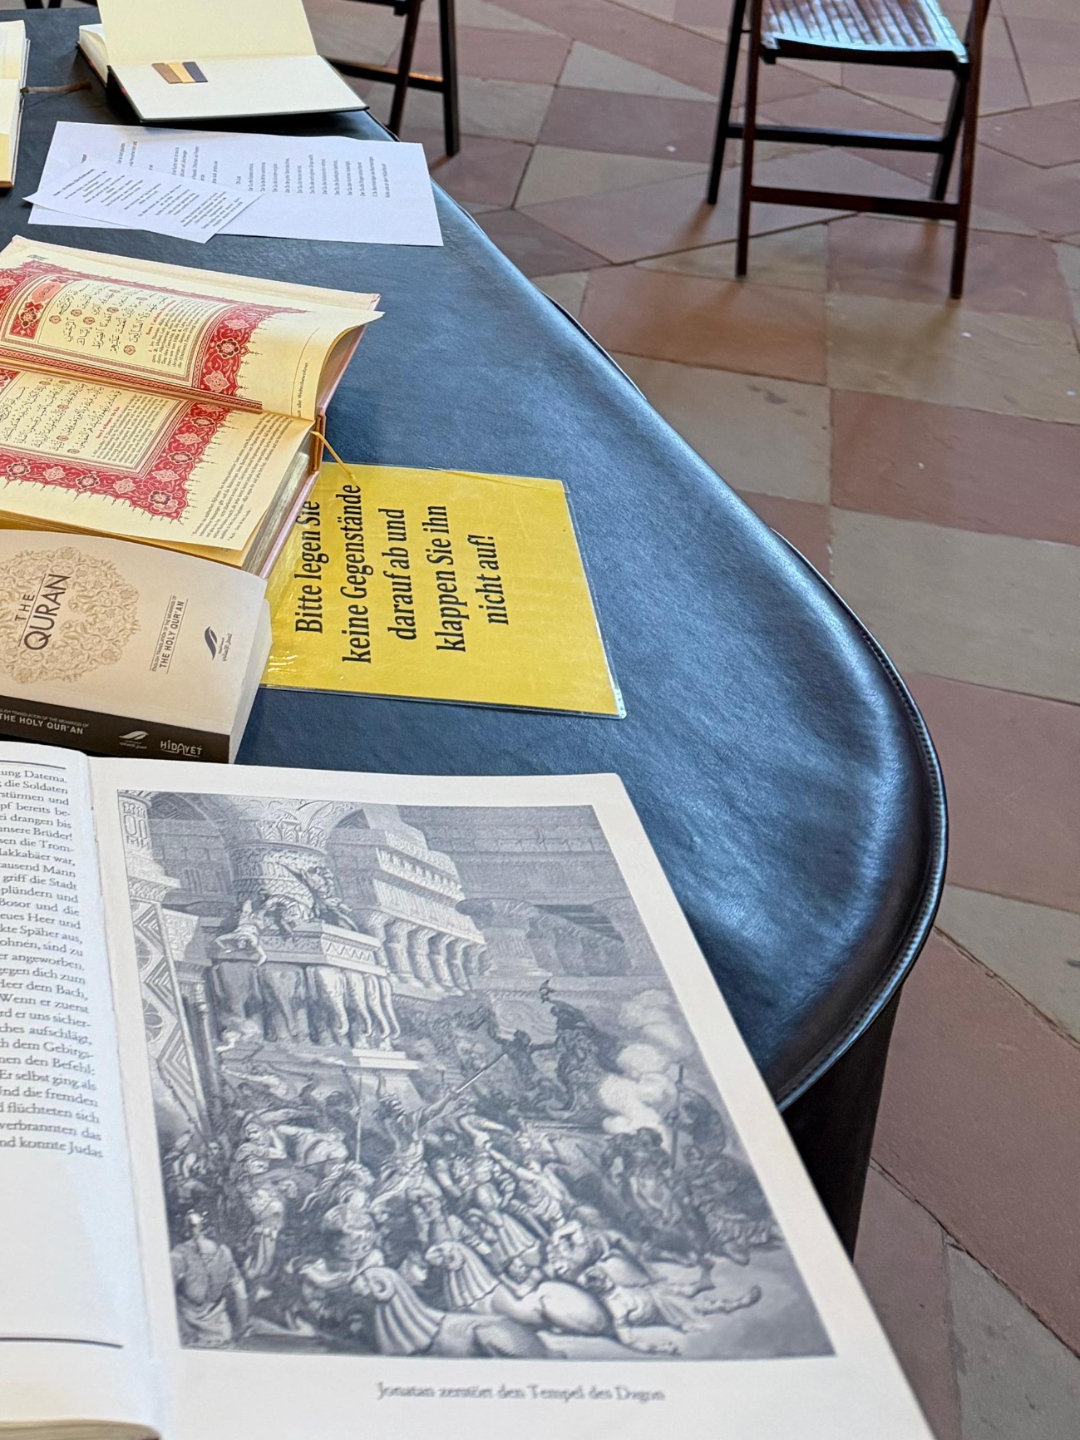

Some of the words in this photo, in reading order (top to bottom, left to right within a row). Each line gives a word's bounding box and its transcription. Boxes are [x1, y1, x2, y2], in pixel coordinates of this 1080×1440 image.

[296, 500, 320, 526] Sie
[378, 508, 407, 542] und
[422, 506, 449, 534] ihn
[294, 530, 329, 580] legen
[336, 484, 374, 599] Gegenstände
[425, 538, 454, 565] Sie
[467, 534, 499, 570] auf!
[381, 546, 410, 570] ab
[15, 594, 35, 621] THE
[24, 574, 71, 650] QURAN
[295, 584, 323, 634] Bitte
[383, 571, 417, 640] darauf
[435, 571, 470, 652] klappen
[475, 573, 509, 625] nicht
[170, 601, 184, 629] QUR'AN
[164, 631, 176, 651] HOLY
[342, 604, 371, 663] keine
[151, 655, 159, 672] ENGLISH
[156, 631, 166, 655] TRANSLATION
[159, 653, 170, 669] THE
[19, 717, 43, 728] HOLY
[46, 722, 84, 735] QUR'AN
[48, 797, 68, 805] und
[10, 813, 52, 826] drangen
[57, 818, 71, 829] bis
[27, 980, 52, 992] dem
[56, 984, 87, 1000] Bach,
[19, 1137, 66, 1151] konnte
[67, 1141, 103, 1157] Judas
[377, 1382, 434, 1400] Jonatan
[438, 1384, 492, 1398] zerstört
[498, 1384, 525, 1398] den
[530, 1384, 584, 1403] Tempel
[588, 1385, 612, 1399] des
